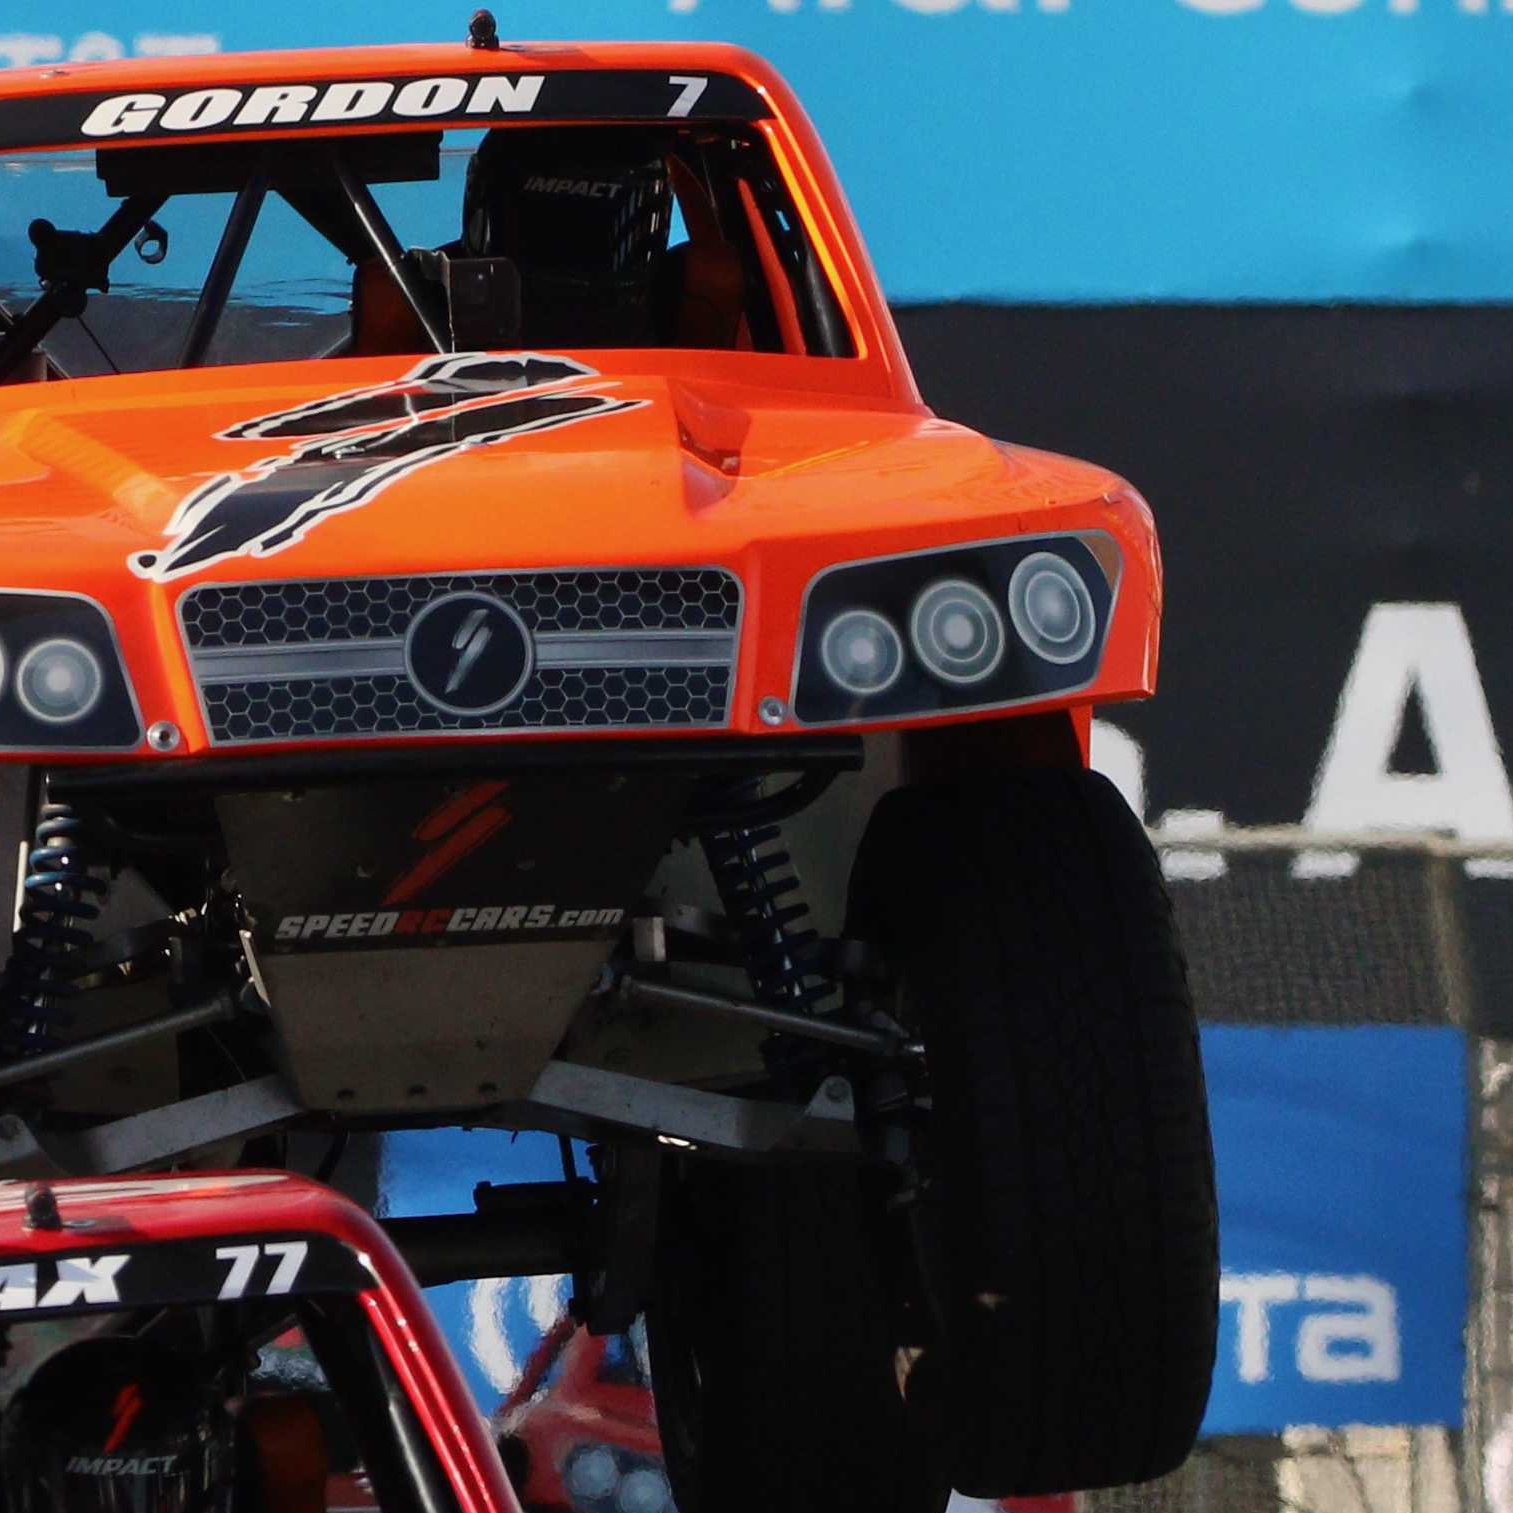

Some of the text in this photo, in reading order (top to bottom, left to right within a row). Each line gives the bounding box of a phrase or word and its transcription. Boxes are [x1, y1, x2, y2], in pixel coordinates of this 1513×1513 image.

[81, 75, 708, 136] GORDON 7
[523, 176, 623, 199] IMPACT
[216, 1241, 308, 1299] 77
[65, 1454, 177, 1475] IMPACT
